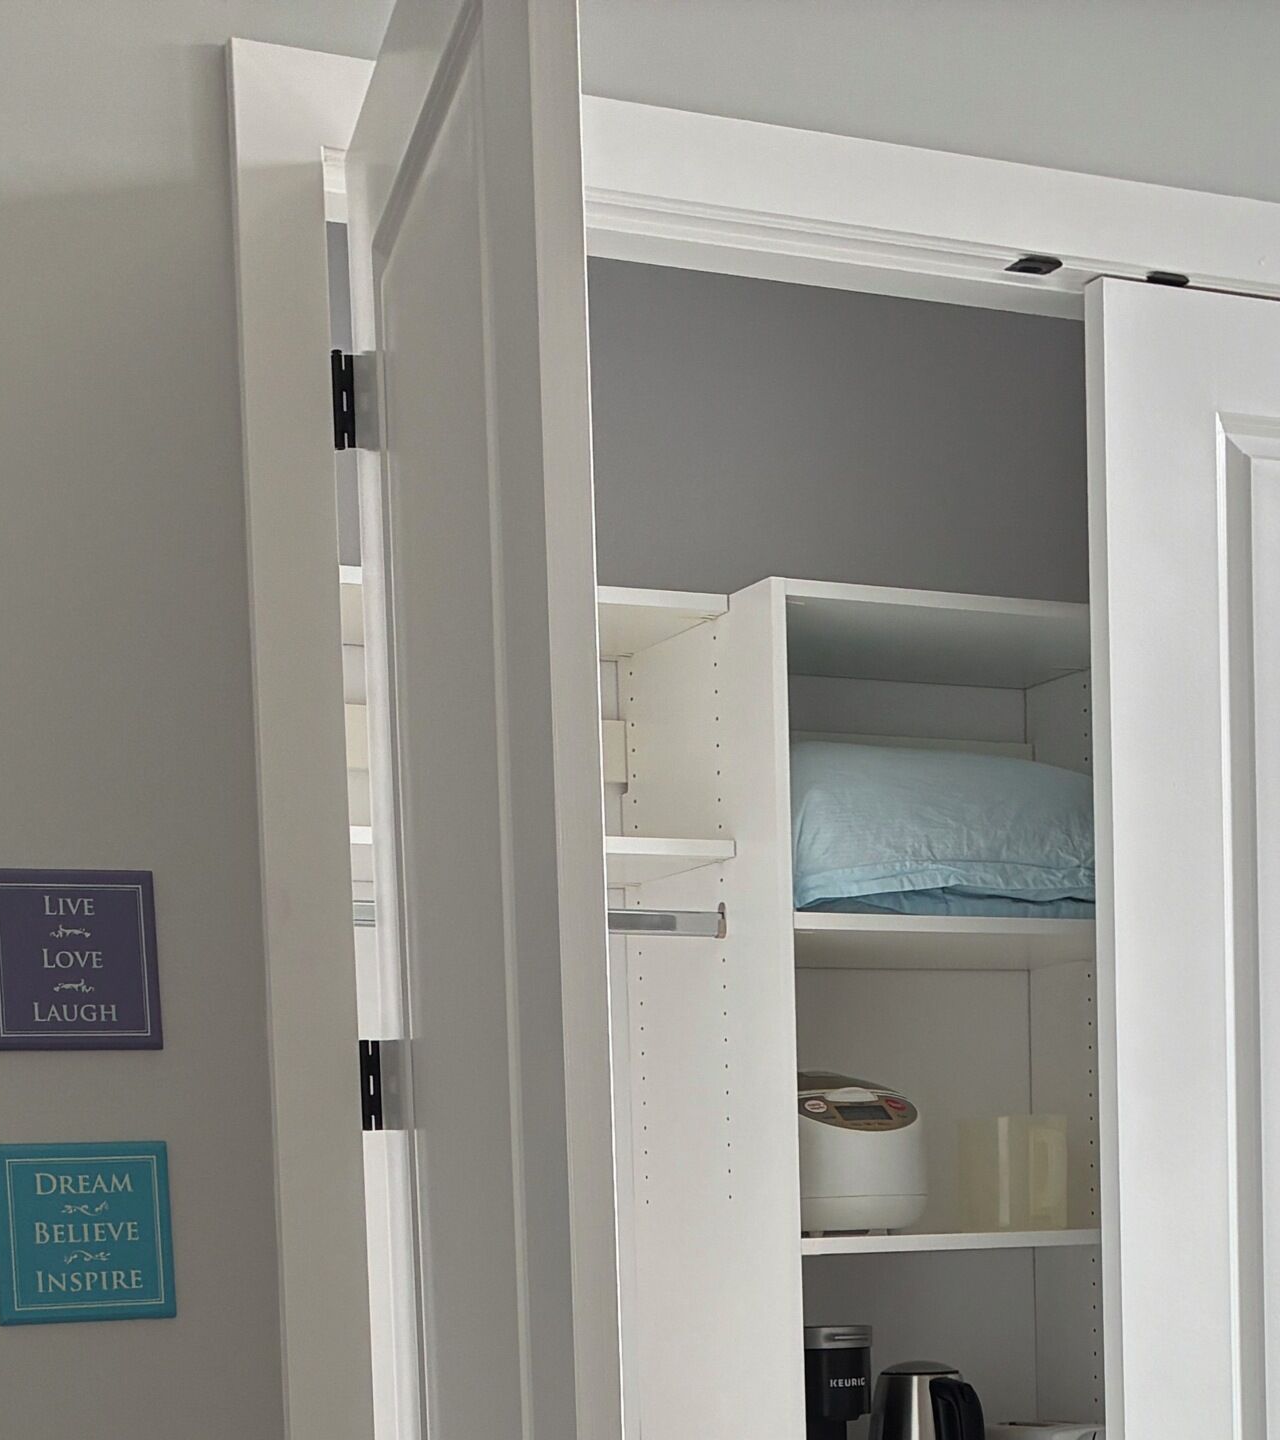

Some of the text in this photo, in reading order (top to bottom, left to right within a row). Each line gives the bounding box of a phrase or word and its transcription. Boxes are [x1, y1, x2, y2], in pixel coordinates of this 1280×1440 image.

[43, 895, 96, 916] LIVE
[42, 948, 104, 969] LOVE
[33, 1002, 118, 1022] LAUGH
[35, 1172, 134, 1195] DREAM
[34, 1221, 140, 1245] BELIEVE
[36, 1269, 144, 1293] INSPIRE
